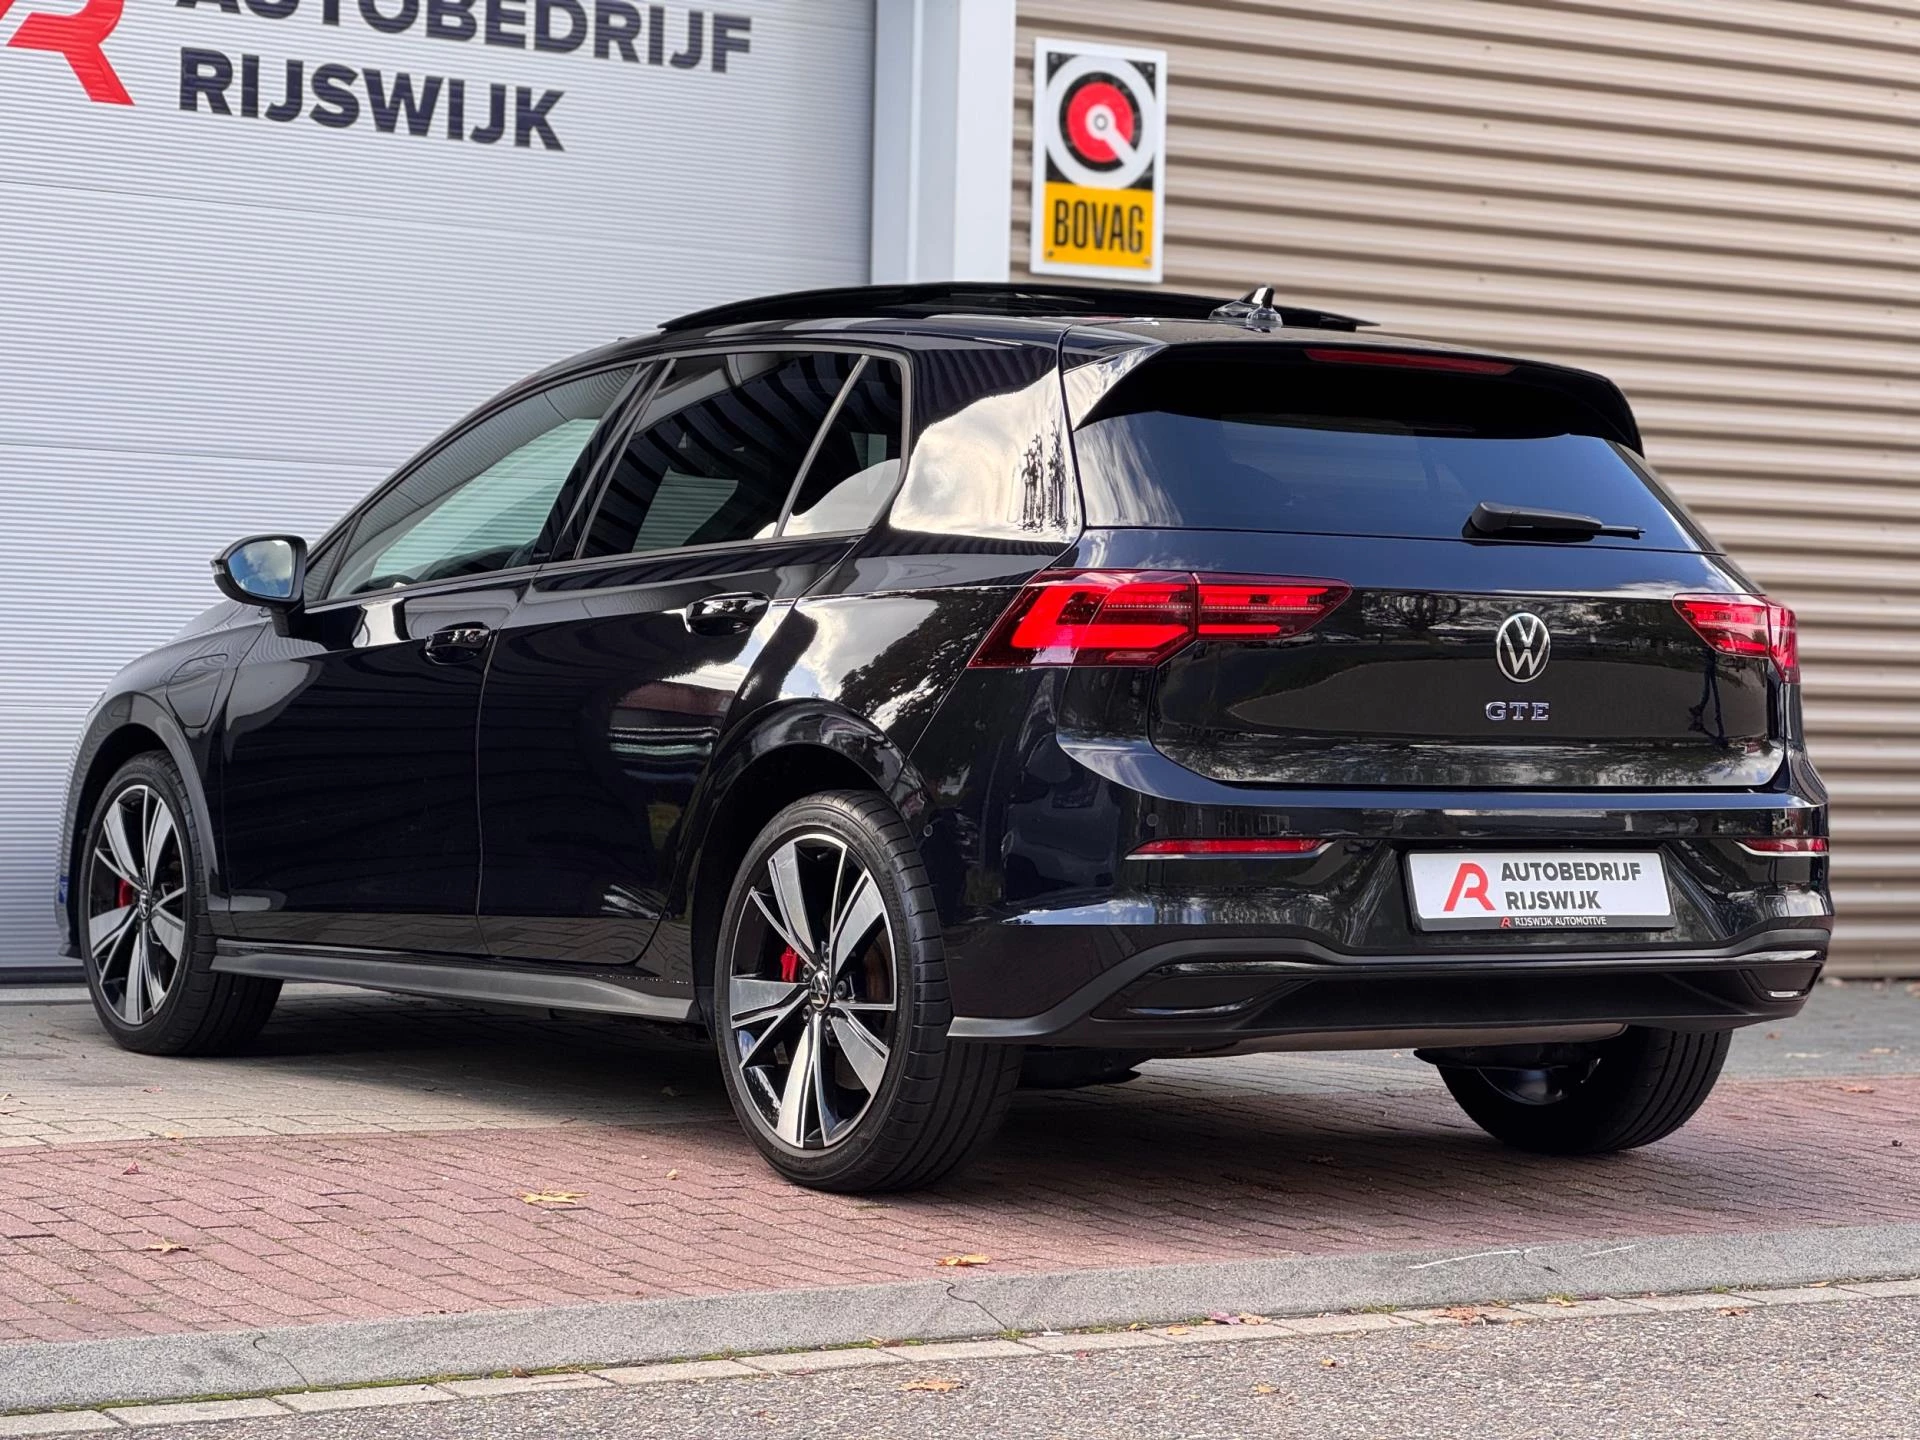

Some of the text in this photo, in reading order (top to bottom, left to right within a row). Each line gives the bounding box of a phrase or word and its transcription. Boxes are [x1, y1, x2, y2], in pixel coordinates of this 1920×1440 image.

[176, 0, 752, 74] OBEDRIJF
[179, 46, 566, 152] RIJSWIJK
[1053, 199, 1145, 254] BOVAG
[1485, 701, 1550, 721] GTE
[1501, 862, 1642, 882] AUTOBEDRIJF
[1505, 890, 1603, 911] RIJSWIJK
[1514, 917, 1554, 927] RIJSWIJK
[1555, 916, 1608, 926] AUTOMOTIVE
